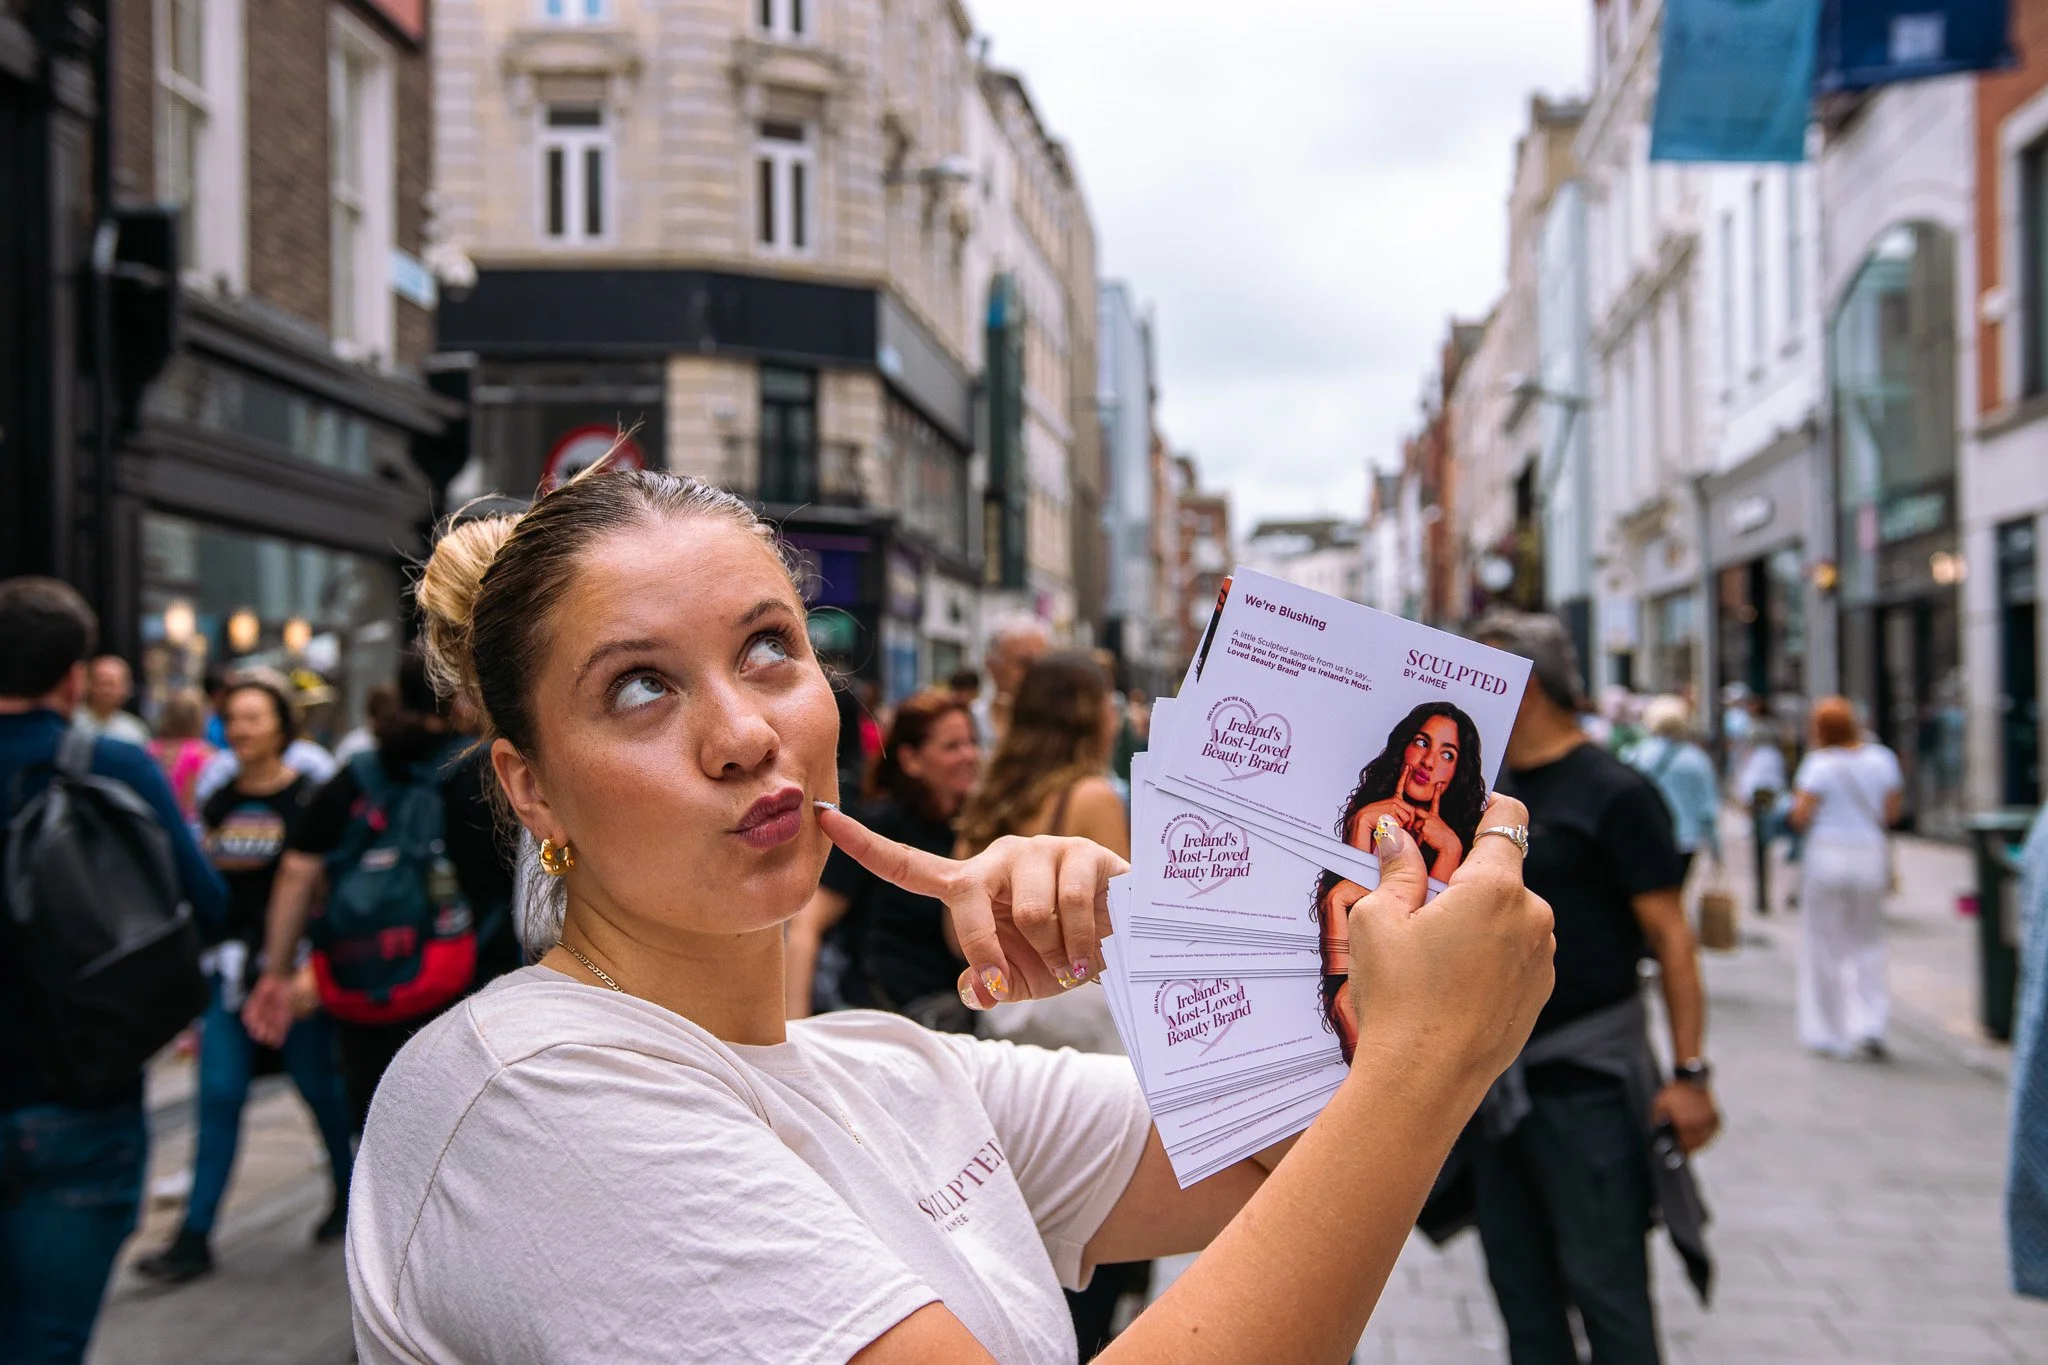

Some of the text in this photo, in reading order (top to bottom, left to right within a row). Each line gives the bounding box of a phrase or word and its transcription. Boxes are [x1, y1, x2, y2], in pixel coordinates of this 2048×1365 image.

[1279, 606, 1326, 631] Blushing
[1227, 647, 1300, 677] Loved Beauty Brand
[1230, 638, 1251, 650] Thank
[1253, 645, 1266, 656] you
[1268, 648, 1278, 659] for
[1280, 655, 1306, 670] making
[1308, 665, 1316, 673] us
[1351, 678, 1372, 692] Most-
[1240, 631, 1256, 642] little
[1258, 637, 1288, 653] Sculpted
[1290, 648, 1315, 663] sample
[1317, 657, 1333, 668] from
[1335, 664, 1343, 672] us
[1345, 667, 1353, 675] to
[1403, 669, 1448, 690] BY AIMEE
[1407, 649, 1507, 695] SCULPTED
[1228, 717, 1282, 741] Ireland's
[1202, 743, 1247, 767] Beauty
[1210, 729, 1291, 758] Most-Loved
[1183, 832, 1237, 847] Ireland's
[1169, 847, 1250, 863] Most-Loved
[1163, 865, 1208, 881] Beauty
[1168, 986, 1246, 1030] Most-Loved
[1167, 1021, 1210, 1047] Beauty
